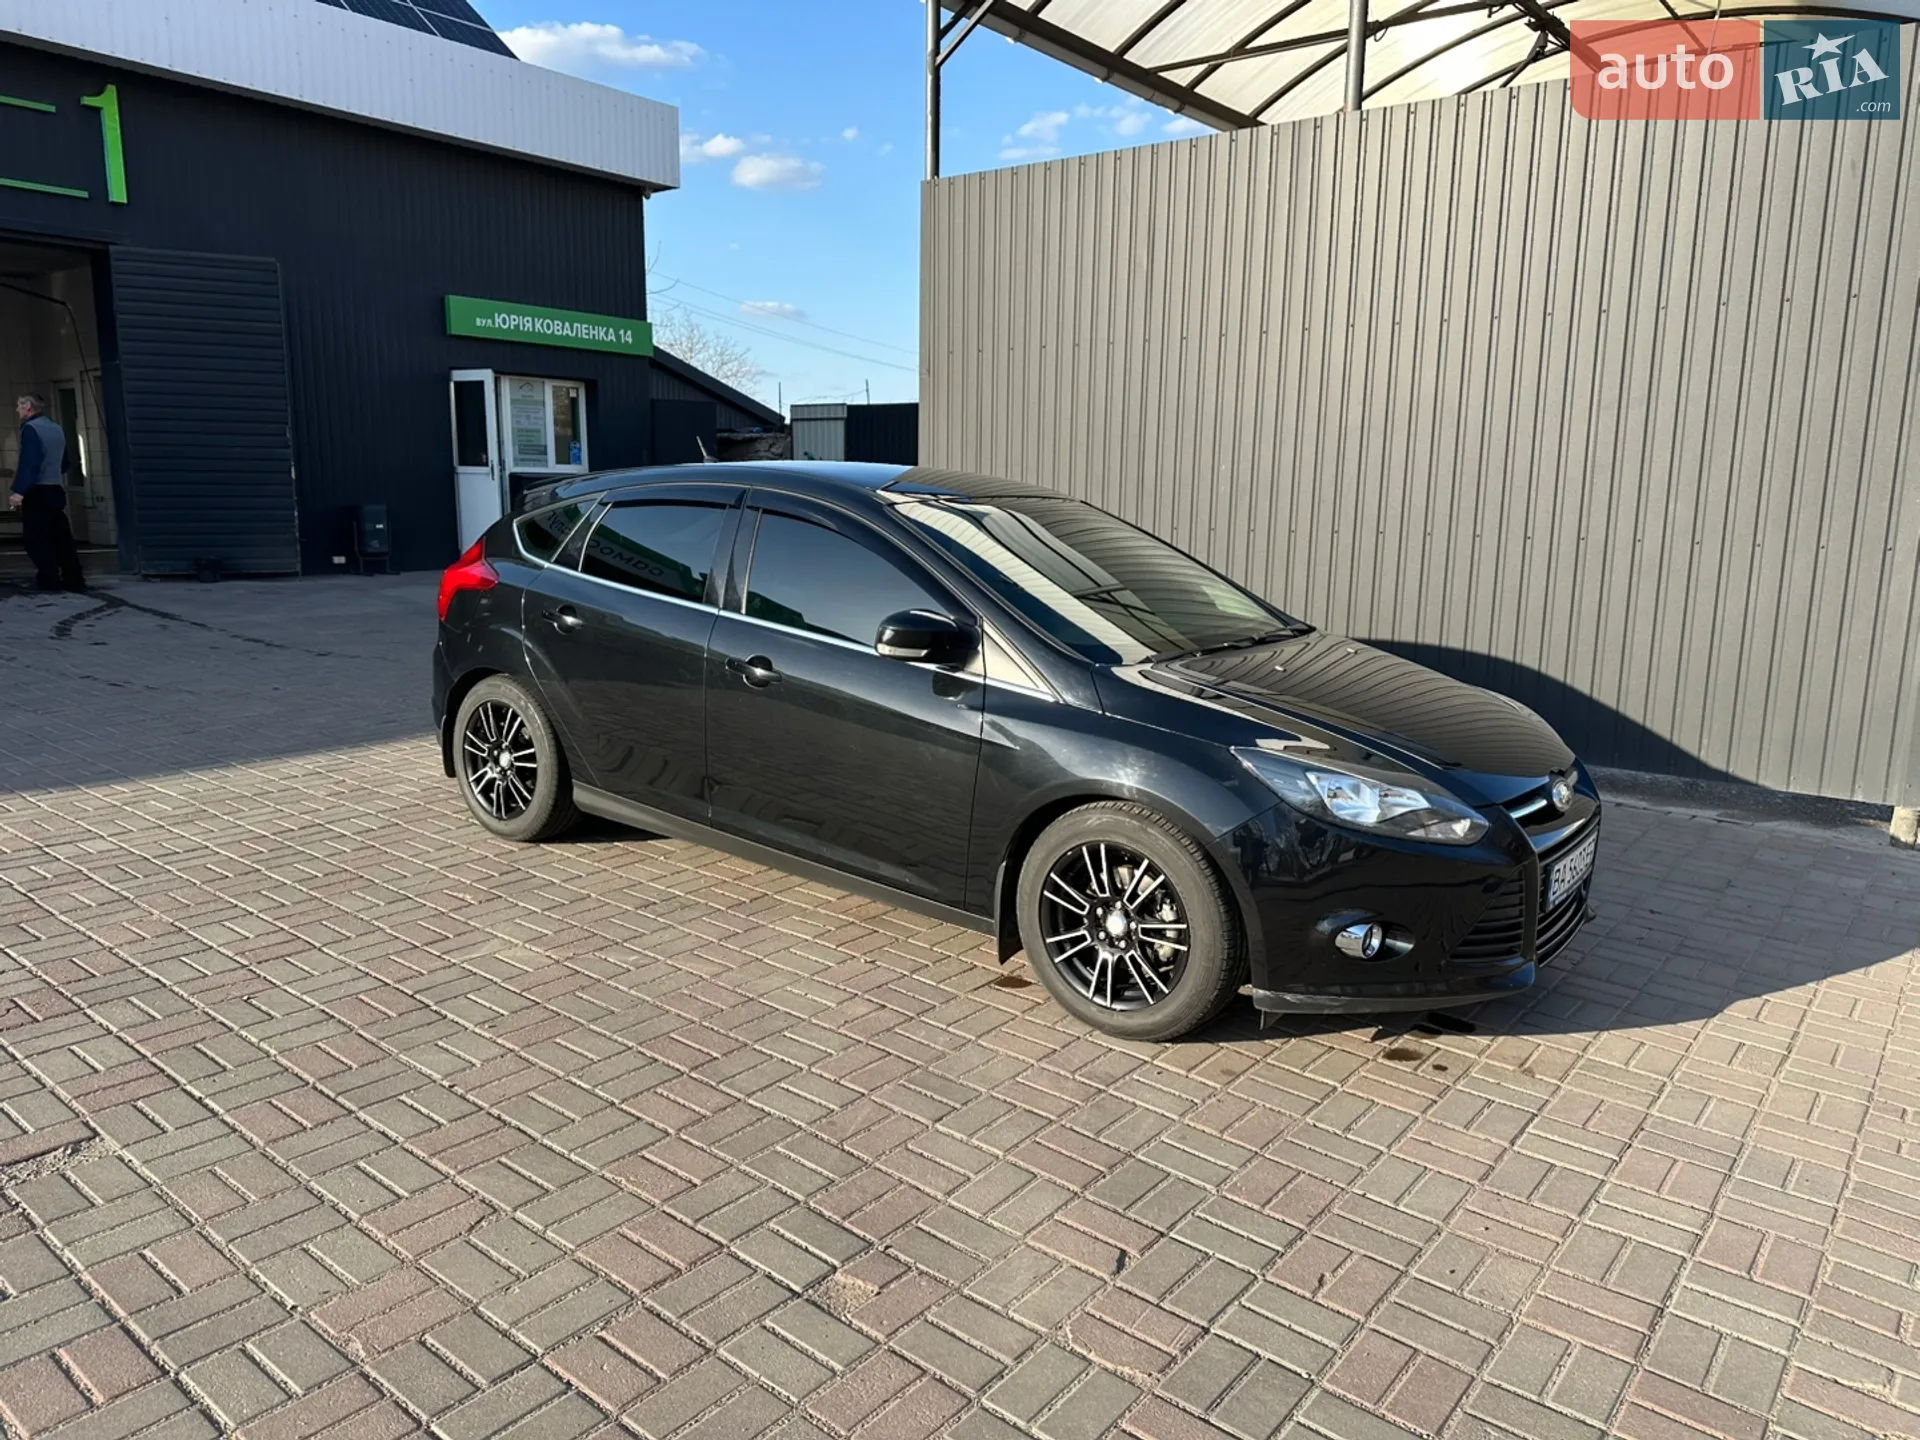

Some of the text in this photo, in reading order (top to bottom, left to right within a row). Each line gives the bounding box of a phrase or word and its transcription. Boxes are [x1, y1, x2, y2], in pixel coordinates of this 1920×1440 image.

[494, 312, 533, 332] ЮРІЯ
[534, 316, 616, 343] КОВАЛЕНКА
[618, 329, 633, 345] 14
